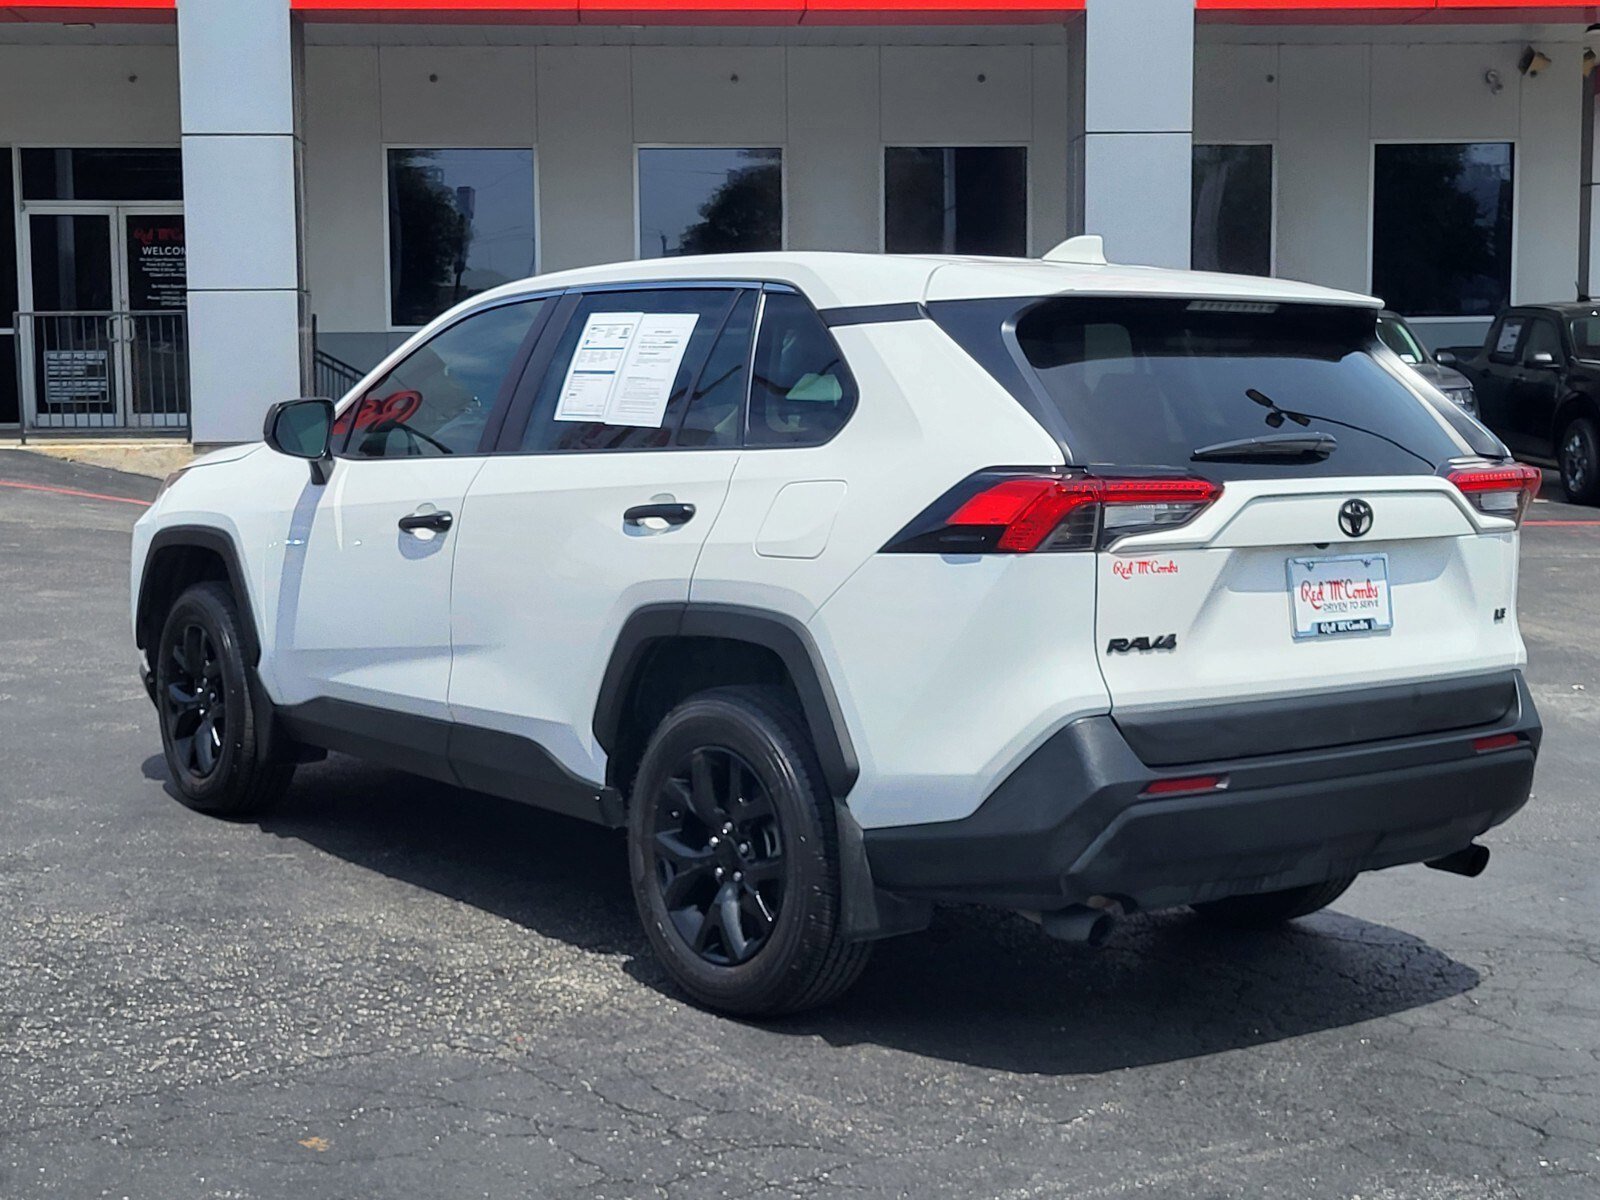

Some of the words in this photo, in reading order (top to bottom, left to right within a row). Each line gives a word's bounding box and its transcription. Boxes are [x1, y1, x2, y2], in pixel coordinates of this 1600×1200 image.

[1113, 560, 1133, 580] Red
[1301, 580, 1325, 610] Red
[1325, 578, 1379, 601] McCombs
[1323, 601, 1347, 612] DRIVEN
[1350, 601, 1359, 610] TO
[1360, 599, 1379, 609] SERVE
[1106, 633, 1177, 654] RAV4
